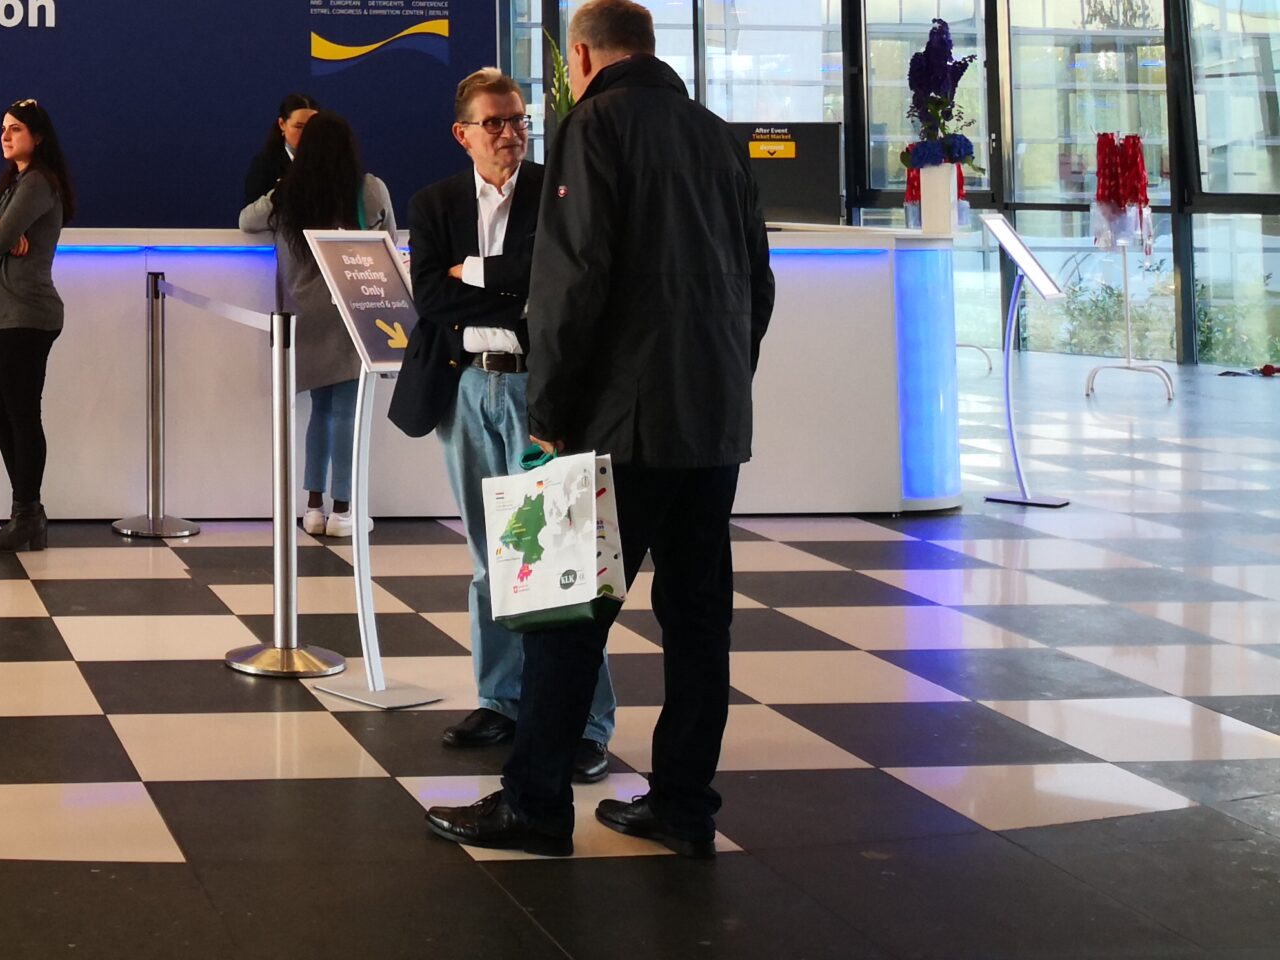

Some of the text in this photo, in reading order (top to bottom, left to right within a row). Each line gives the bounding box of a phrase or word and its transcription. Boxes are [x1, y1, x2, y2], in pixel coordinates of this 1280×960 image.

[342, 254, 374, 267] Badge
[344, 269, 387, 282] Printing
[360, 284, 386, 298] Only
